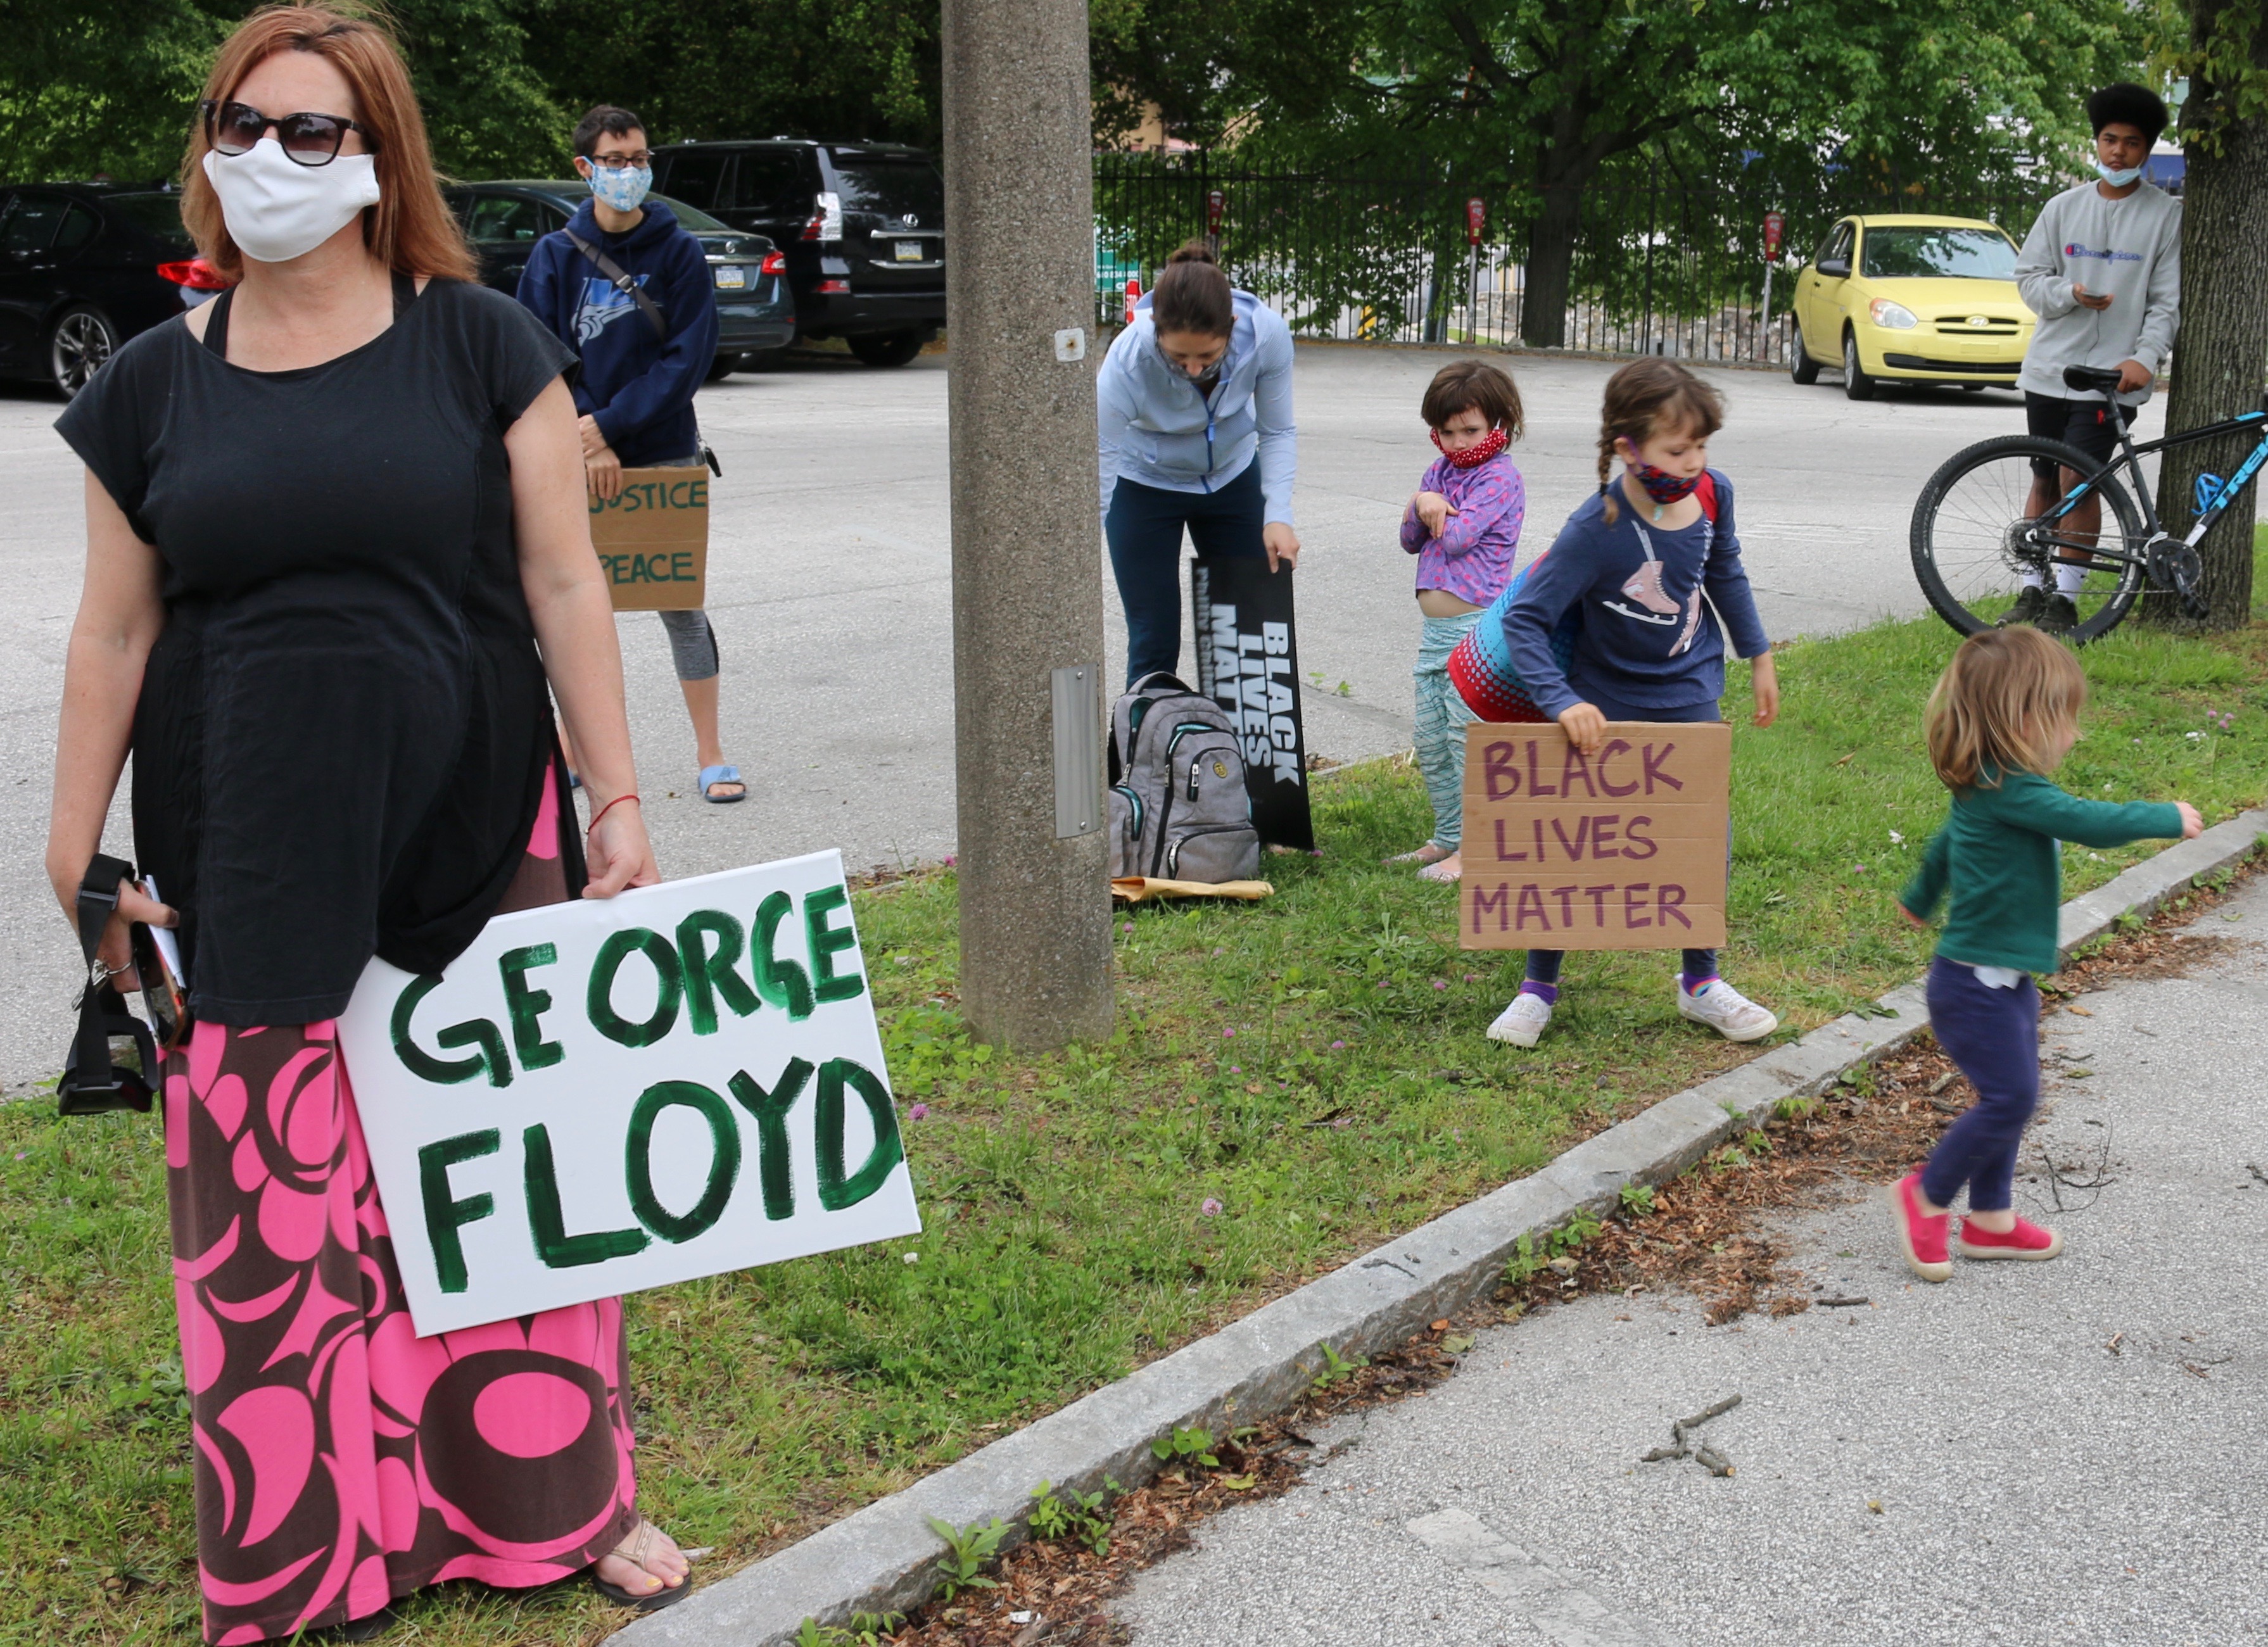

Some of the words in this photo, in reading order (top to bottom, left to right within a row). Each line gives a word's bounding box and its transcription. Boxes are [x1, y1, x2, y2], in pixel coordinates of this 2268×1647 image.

[2209, 432, 2268, 509] TRE
[599, 552, 696, 584] PEACE
[1210, 603, 1248, 776] MATT
[1238, 634, 1272, 767] LIVES
[1262, 621, 1300, 786] BLACK
[1483, 739, 1683, 802] BLACK
[1495, 814, 1658, 862] LIVES
[1473, 882, 1692, 934] MATTER
[390, 883, 865, 1089] GEORGE
[418, 1056, 904, 1294] FLOYD
